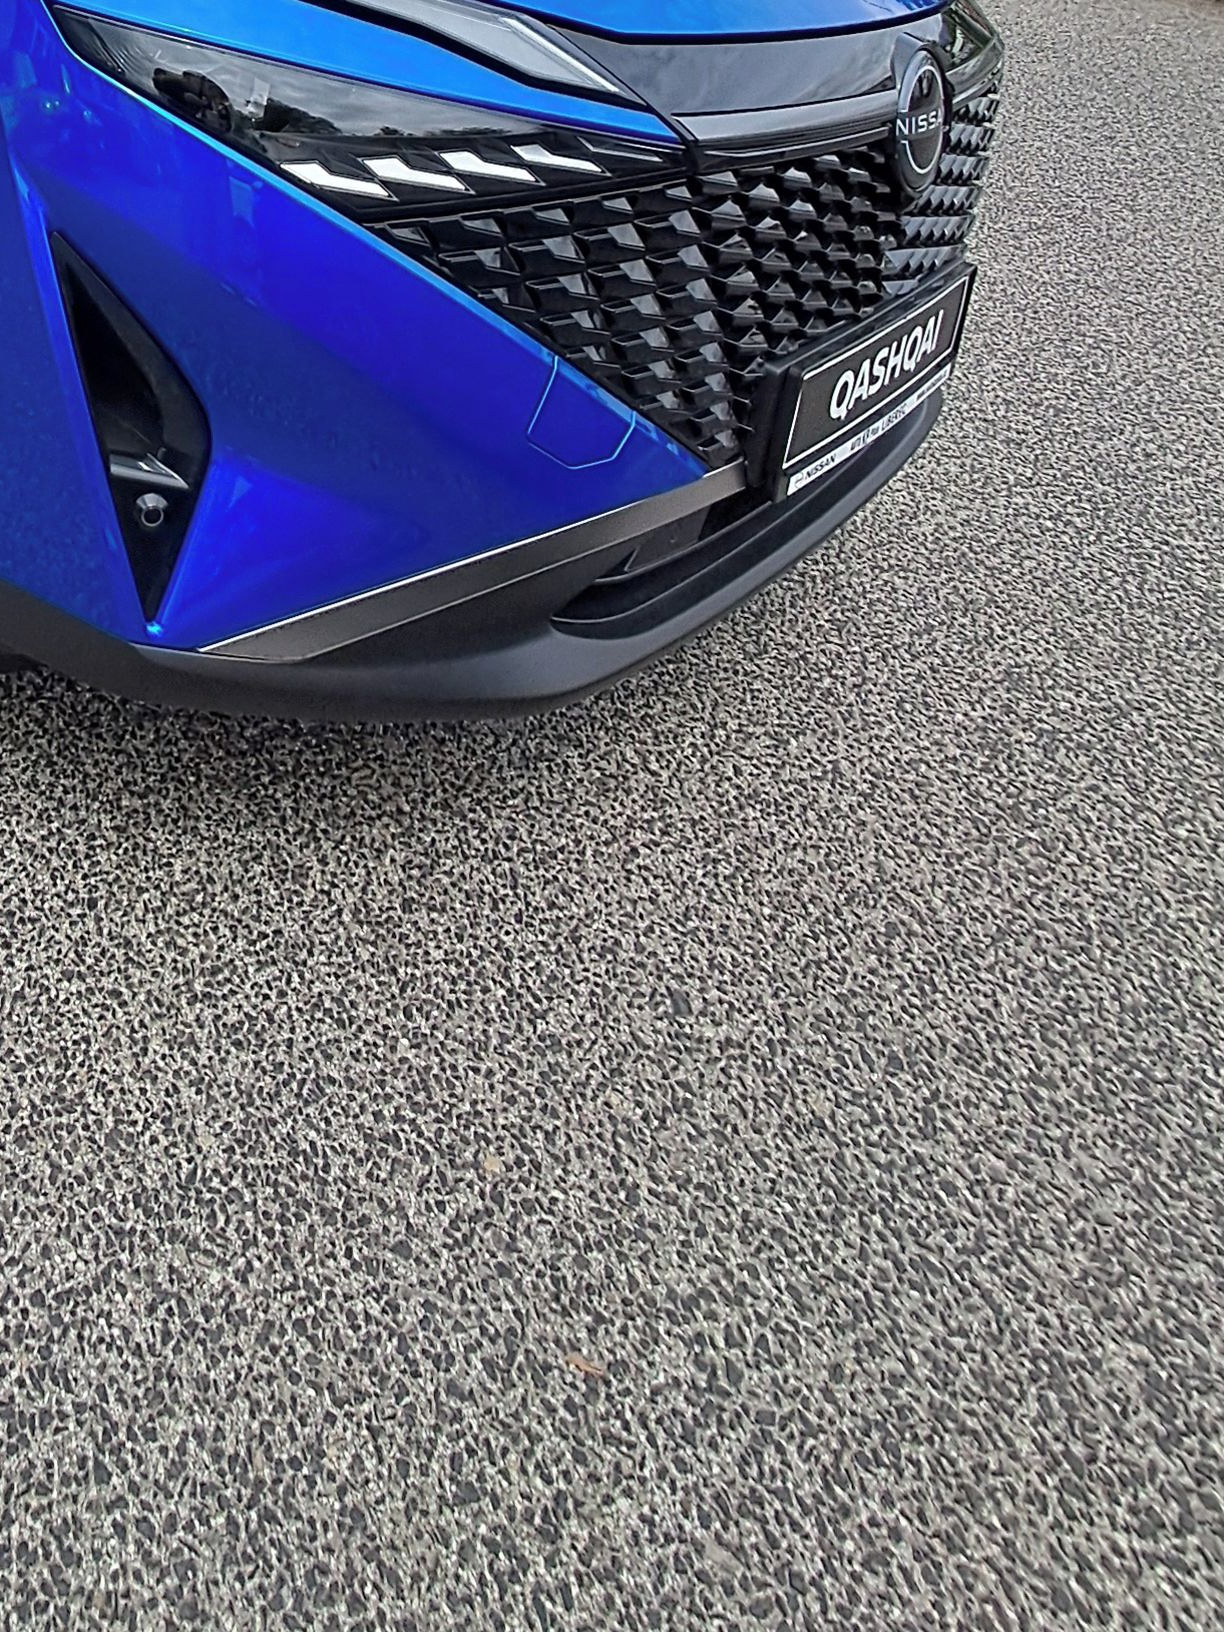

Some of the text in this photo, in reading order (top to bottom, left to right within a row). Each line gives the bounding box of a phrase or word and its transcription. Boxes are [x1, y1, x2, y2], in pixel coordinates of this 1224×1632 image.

[896, 108, 943, 136] NISSA
[829, 309, 944, 421] QASHQAI
[804, 454, 837, 481] NISSAN
